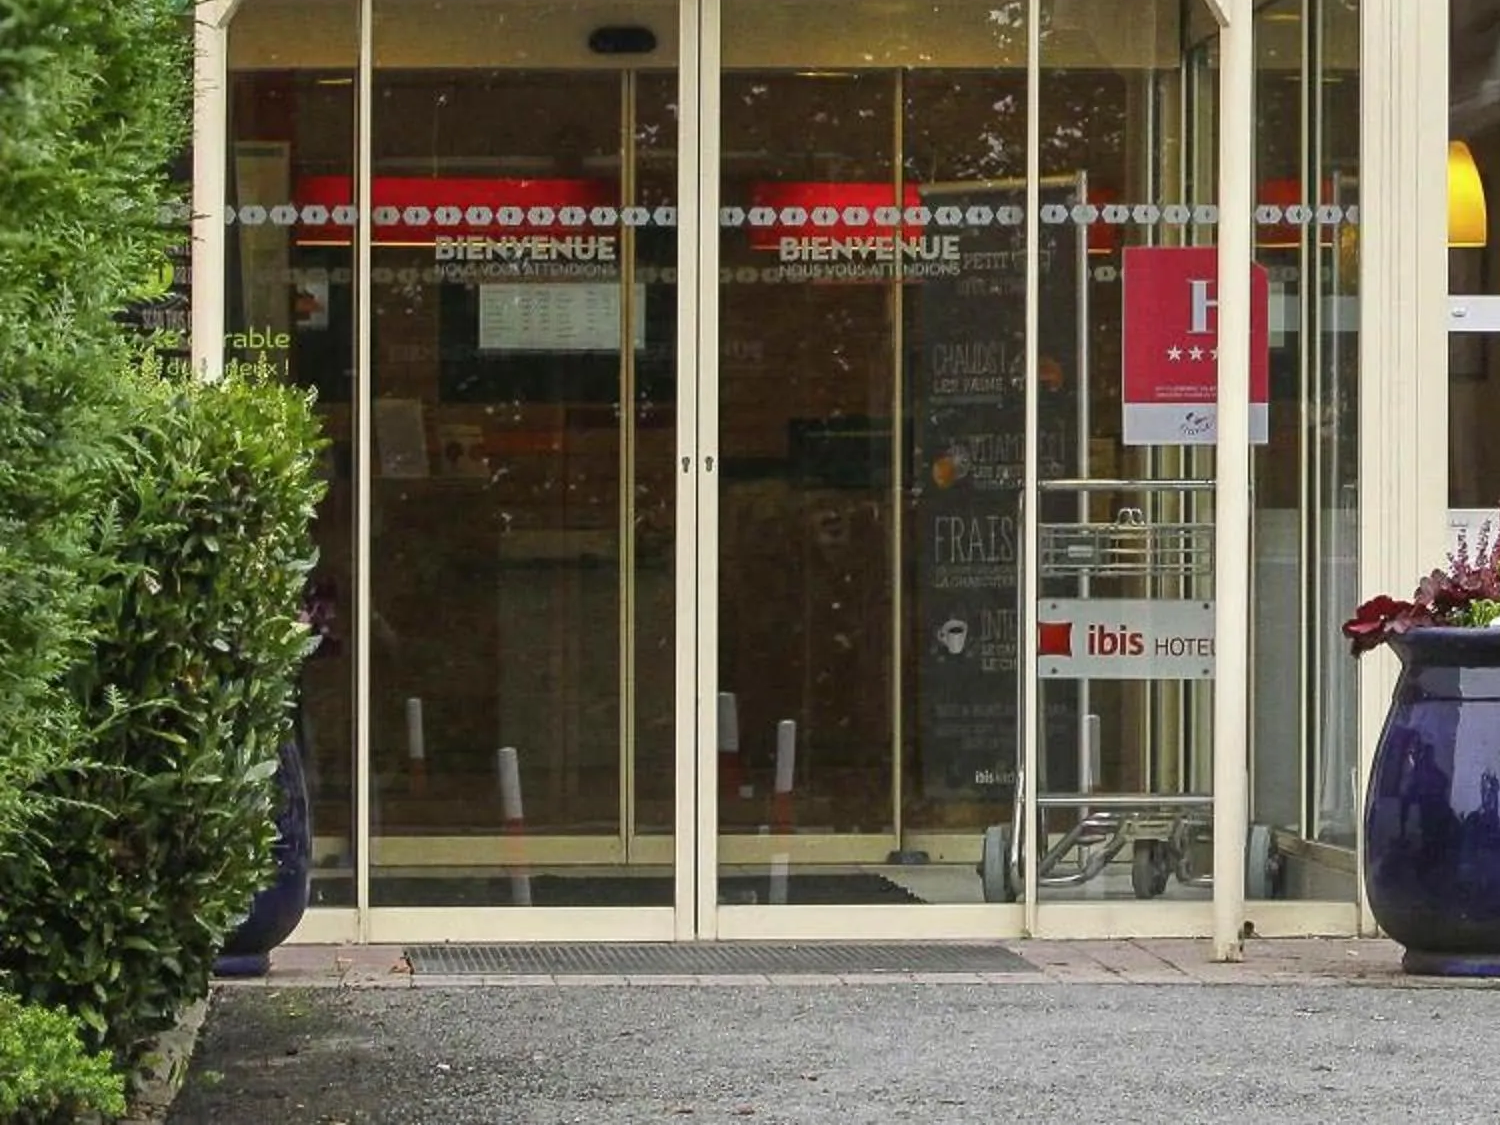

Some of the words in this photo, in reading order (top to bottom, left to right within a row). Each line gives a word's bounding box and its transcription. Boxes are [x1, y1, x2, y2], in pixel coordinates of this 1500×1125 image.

[435, 236, 616, 260] BIENVENUE
[780, 236, 960, 261] BIENVENUE
[779, 262, 821, 275] NOUS
[825, 262, 865, 275] VOUS
[869, 262, 960, 276] ATTENDIONS
[223, 325, 291, 348] rable
[934, 515, 1014, 564] FRAIS
[1088, 625, 1144, 656] ibis
